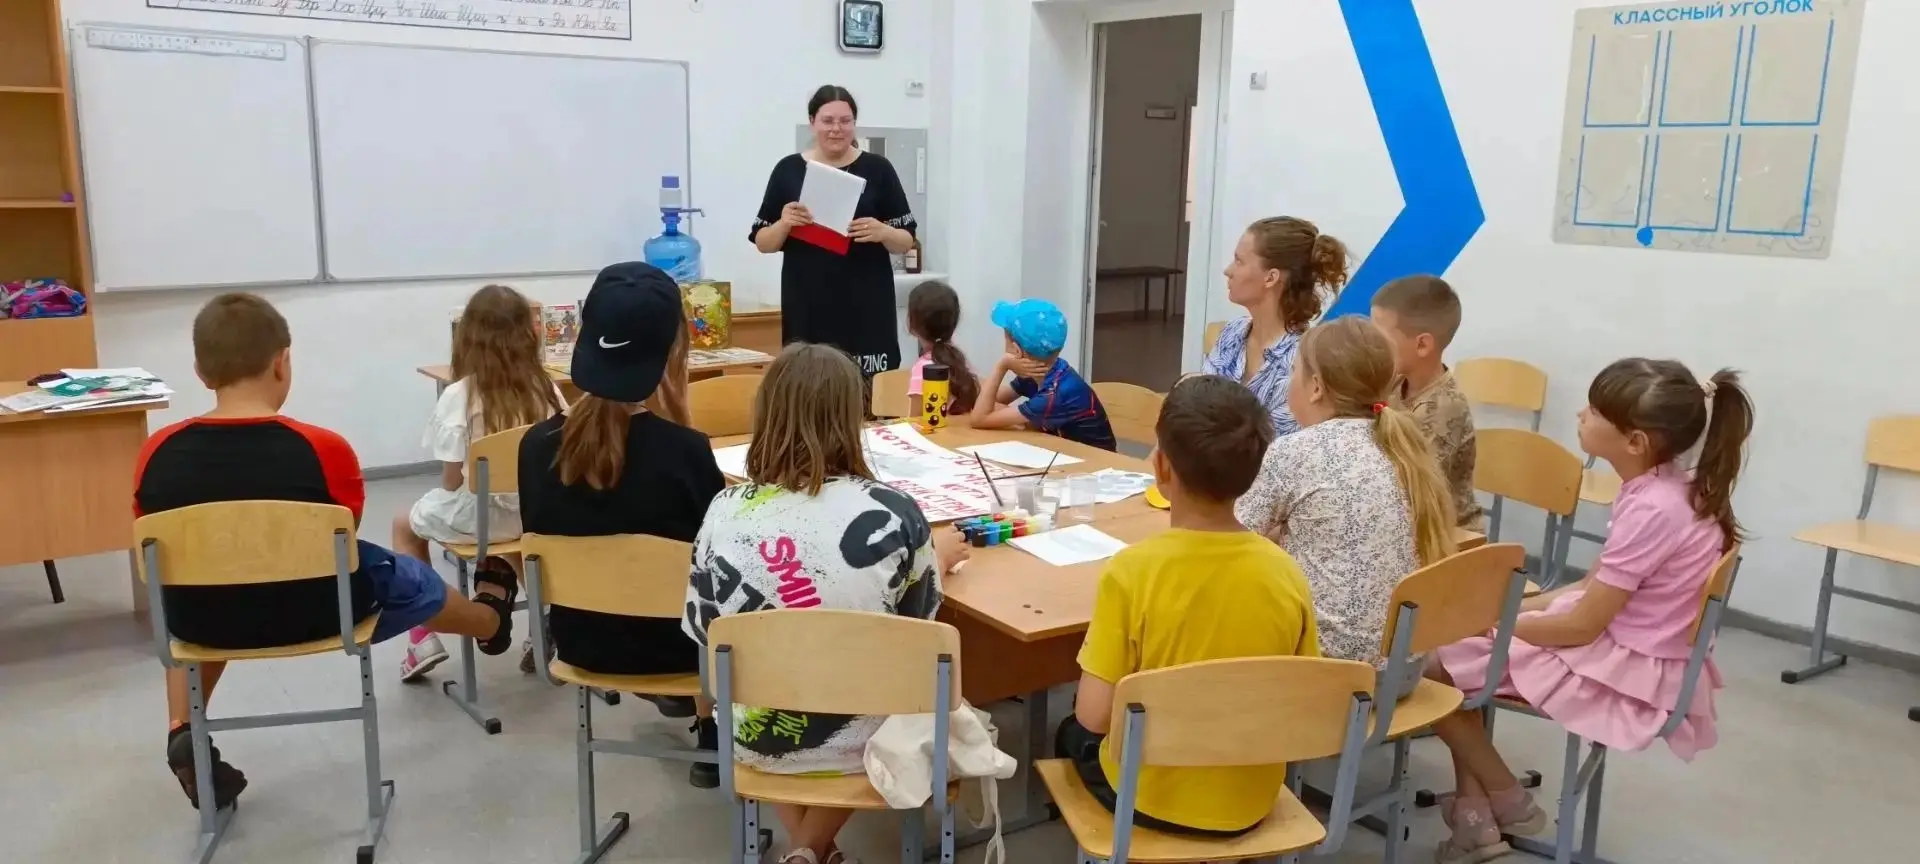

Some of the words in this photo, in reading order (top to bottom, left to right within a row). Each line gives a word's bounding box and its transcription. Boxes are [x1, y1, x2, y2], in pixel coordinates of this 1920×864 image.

[1613, 1, 1724, 25] КЛАССНЫЙ
[1728, 0, 1814, 17] УГОЛОК
[853, 353, 887, 373] AZING
[772, 712, 808, 745] THE
